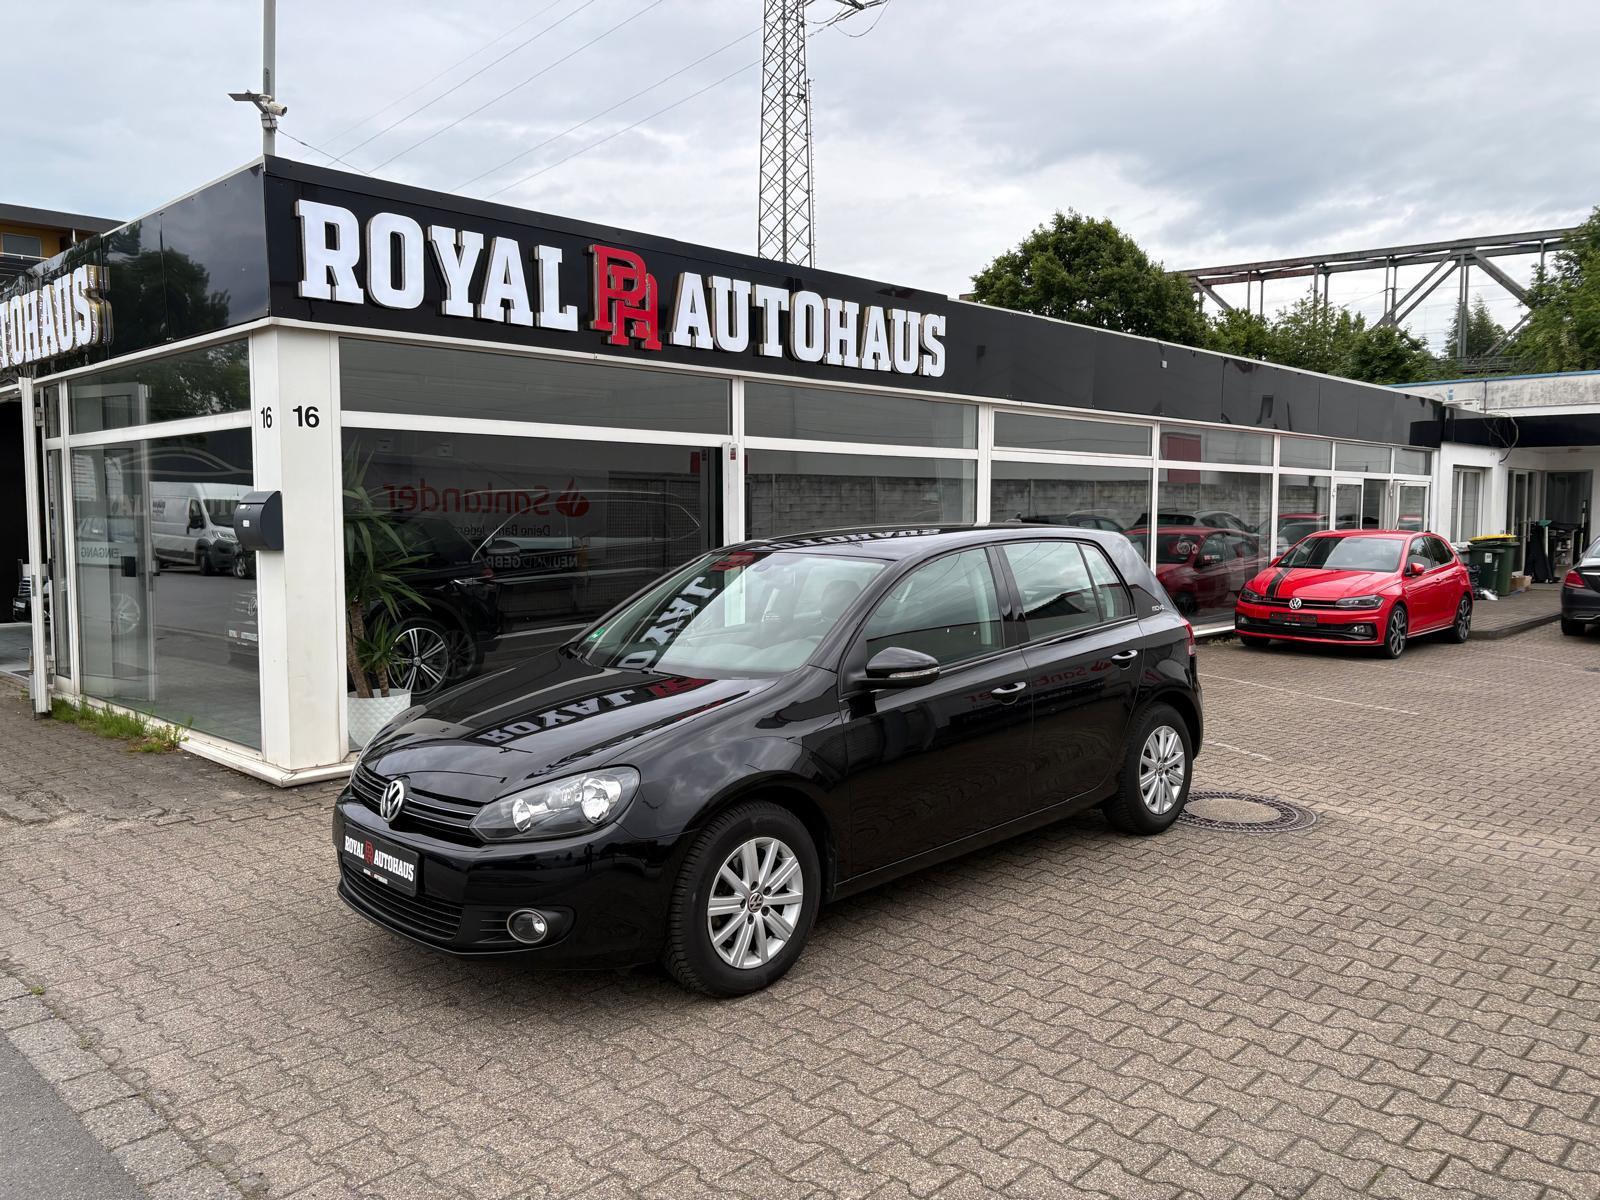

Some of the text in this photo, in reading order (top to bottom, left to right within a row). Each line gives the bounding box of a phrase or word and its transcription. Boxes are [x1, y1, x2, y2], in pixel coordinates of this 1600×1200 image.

[295, 199, 579, 332] ROYAL
[668, 271, 946, 378] AUTOHAUS
[261, 406, 273, 429] 16
[293, 406, 320, 428] 16
[344, 836, 365, 859] ROYAL
[373, 850, 415, 882] AUTOHAUS
